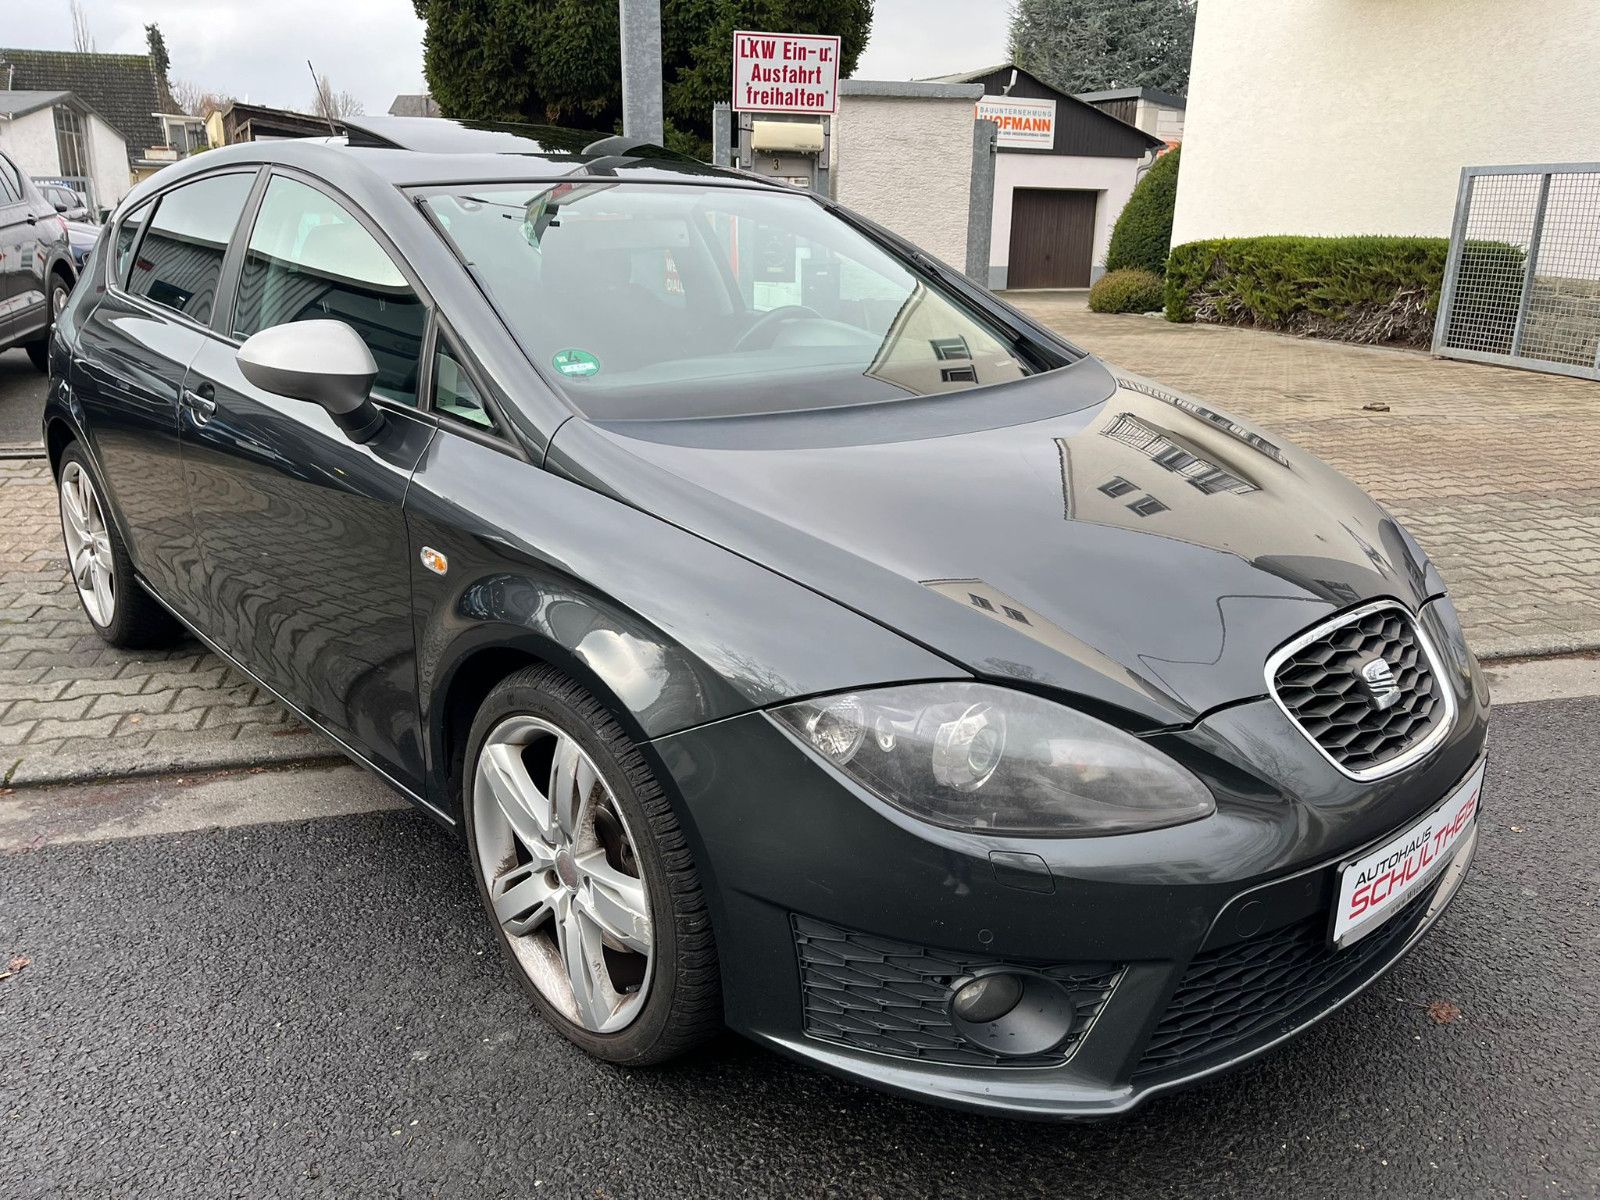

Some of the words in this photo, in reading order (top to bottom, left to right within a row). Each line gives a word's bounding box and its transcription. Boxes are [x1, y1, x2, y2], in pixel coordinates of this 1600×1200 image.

[741, 39, 776, 59] LKW
[783, 41, 816, 61] Ein-
[820, 47, 833, 62] u.
[751, 63, 822, 85] Ausfahrt
[746, 86, 825, 107] freihalten
[980, 107, 1052, 117] BAUUNTERNEHMUNG
[773, 159, 779, 170] 3
[1349, 788, 1479, 920] SCHULTHEIS
[1354, 826, 1432, 889] AUTOHAUS
